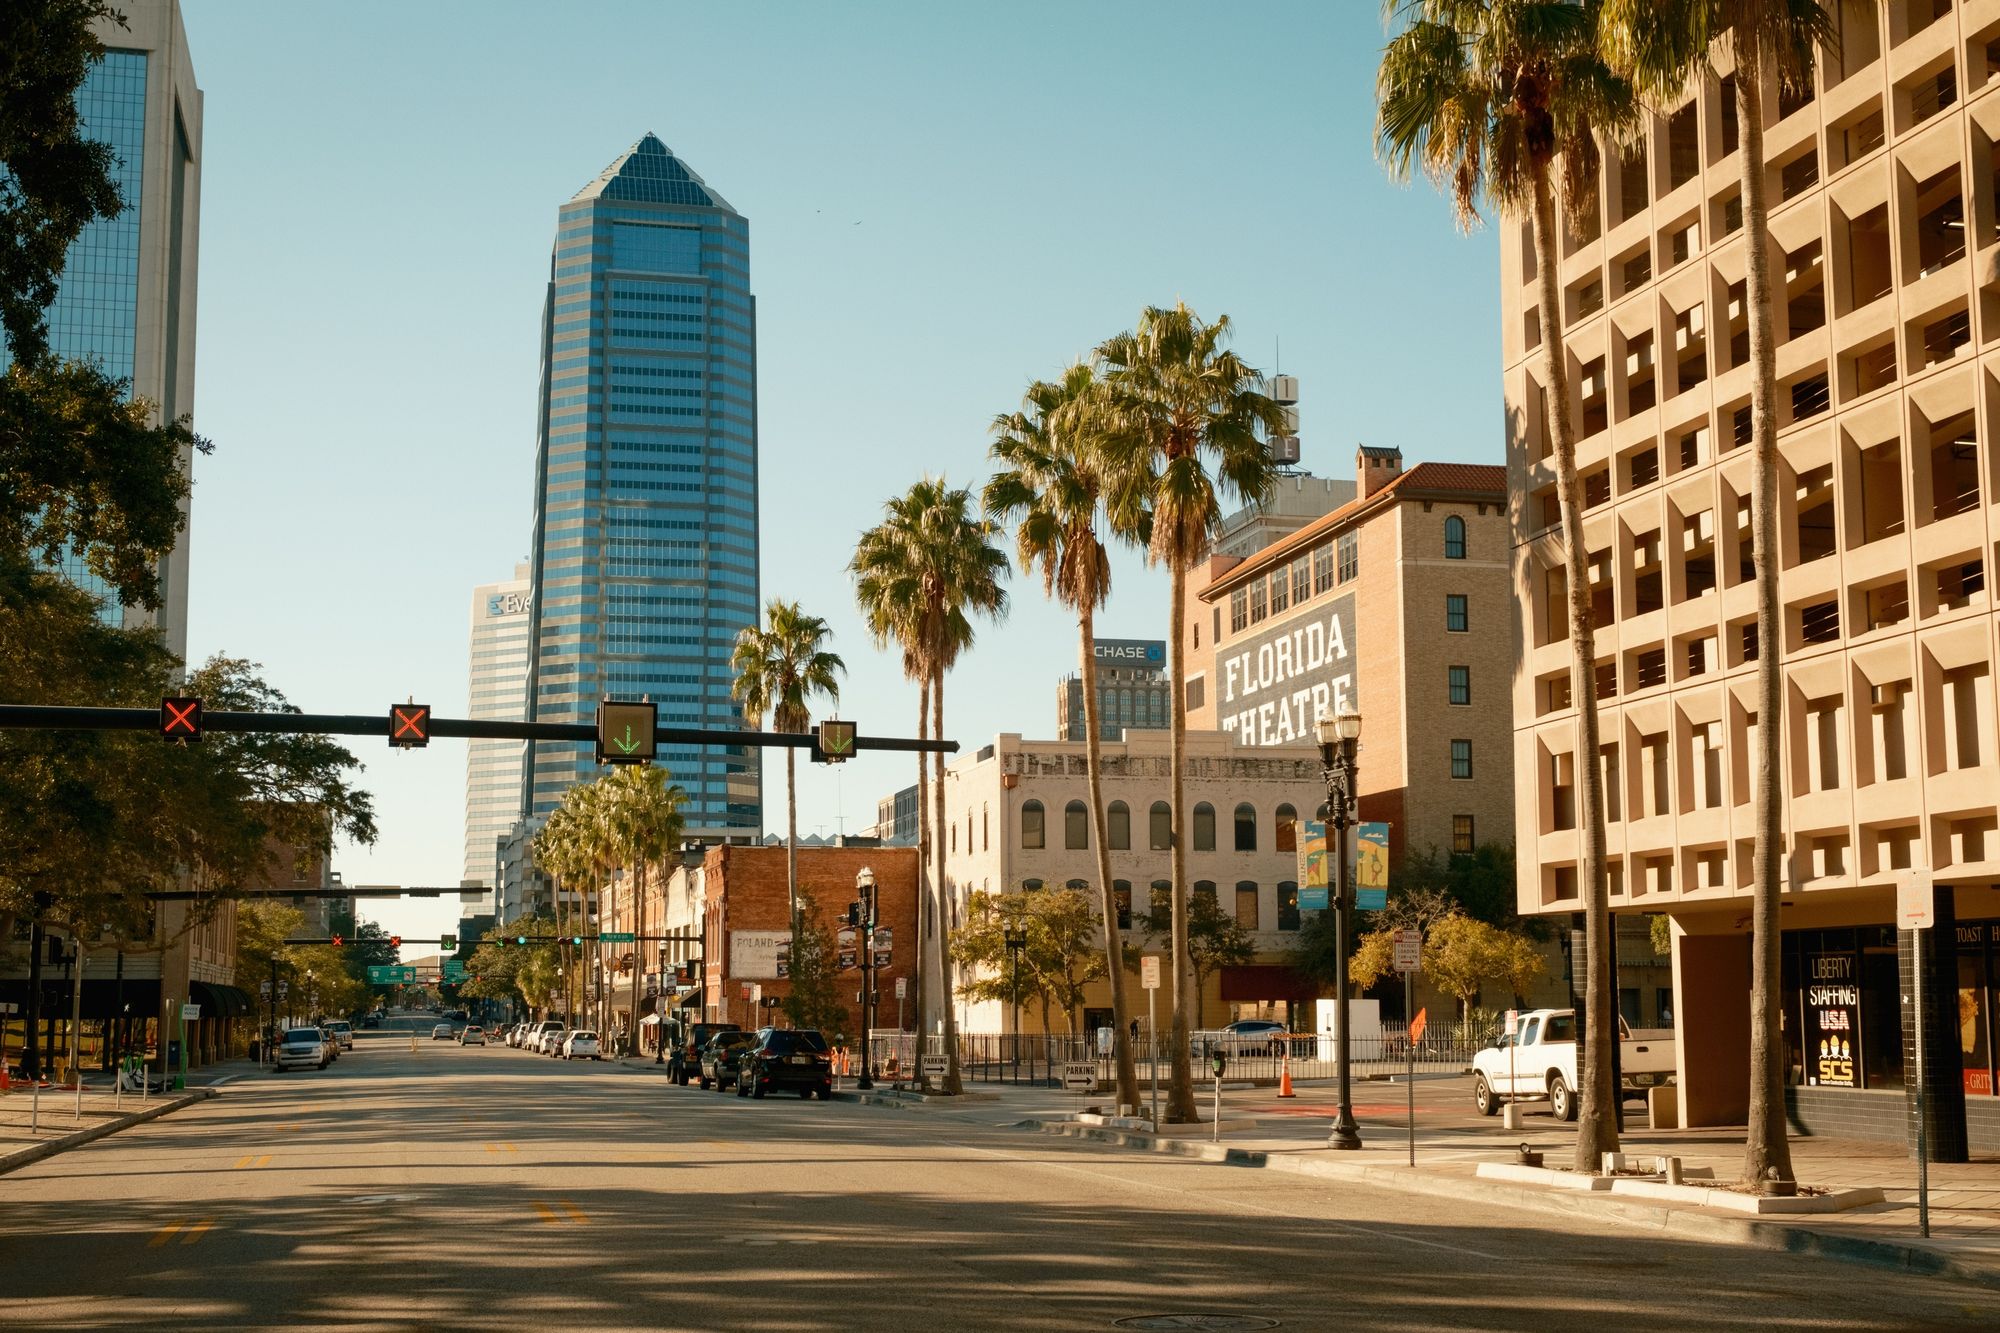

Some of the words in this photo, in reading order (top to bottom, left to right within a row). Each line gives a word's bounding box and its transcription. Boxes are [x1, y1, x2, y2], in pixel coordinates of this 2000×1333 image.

[1094, 646, 1145, 659] CHASE
[1225, 613, 1348, 703] FLORIDA
[1955, 926, 1982, 943] TOAST
[1811, 958, 1851, 979] LIBERTY
[1809, 985, 1856, 1006] STAFFING
[1820, 1010, 1850, 1030] USA
[923, 1057, 948, 1065] PARKING
[1065, 1066, 1095, 1075] PARKING
[1819, 1060, 1854, 1081] SCS
